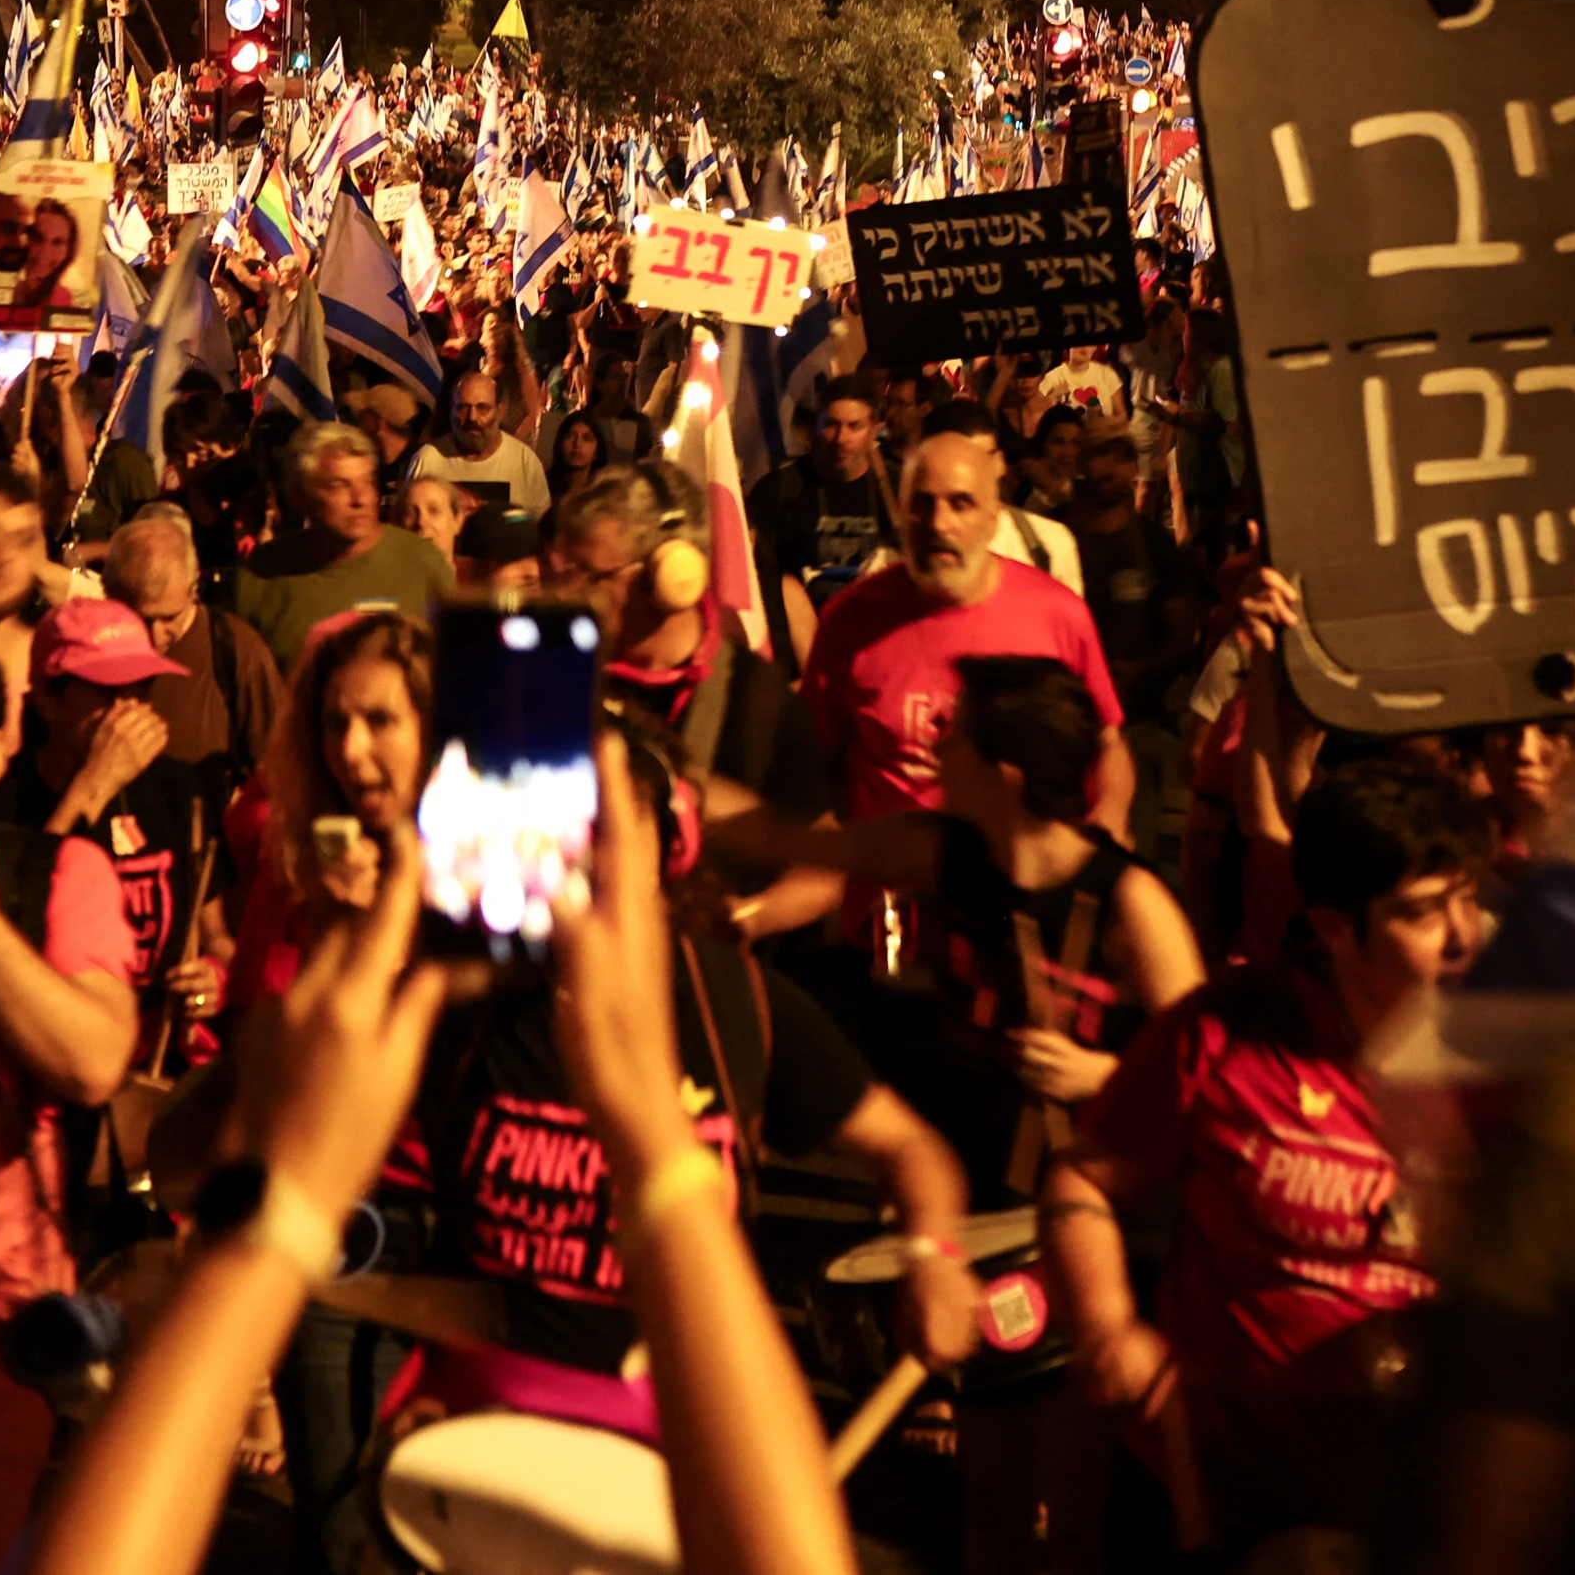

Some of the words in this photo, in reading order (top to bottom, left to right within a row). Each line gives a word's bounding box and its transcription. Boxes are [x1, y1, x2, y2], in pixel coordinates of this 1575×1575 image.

[175, 177, 228, 189] המשטרה
[210, 189, 223, 202] בן
[1060, 192, 1113, 242] לא
[647, 223, 734, 286] ביבי
[861, 227, 900, 261] כי
[908, 210, 1047, 267] אשתוק
[881, 262, 1003, 304] שינתה
[1023, 252, 1117, 291] ארצי
[960, 305, 1041, 341] פניה
[1060, 299, 1122, 337] את
